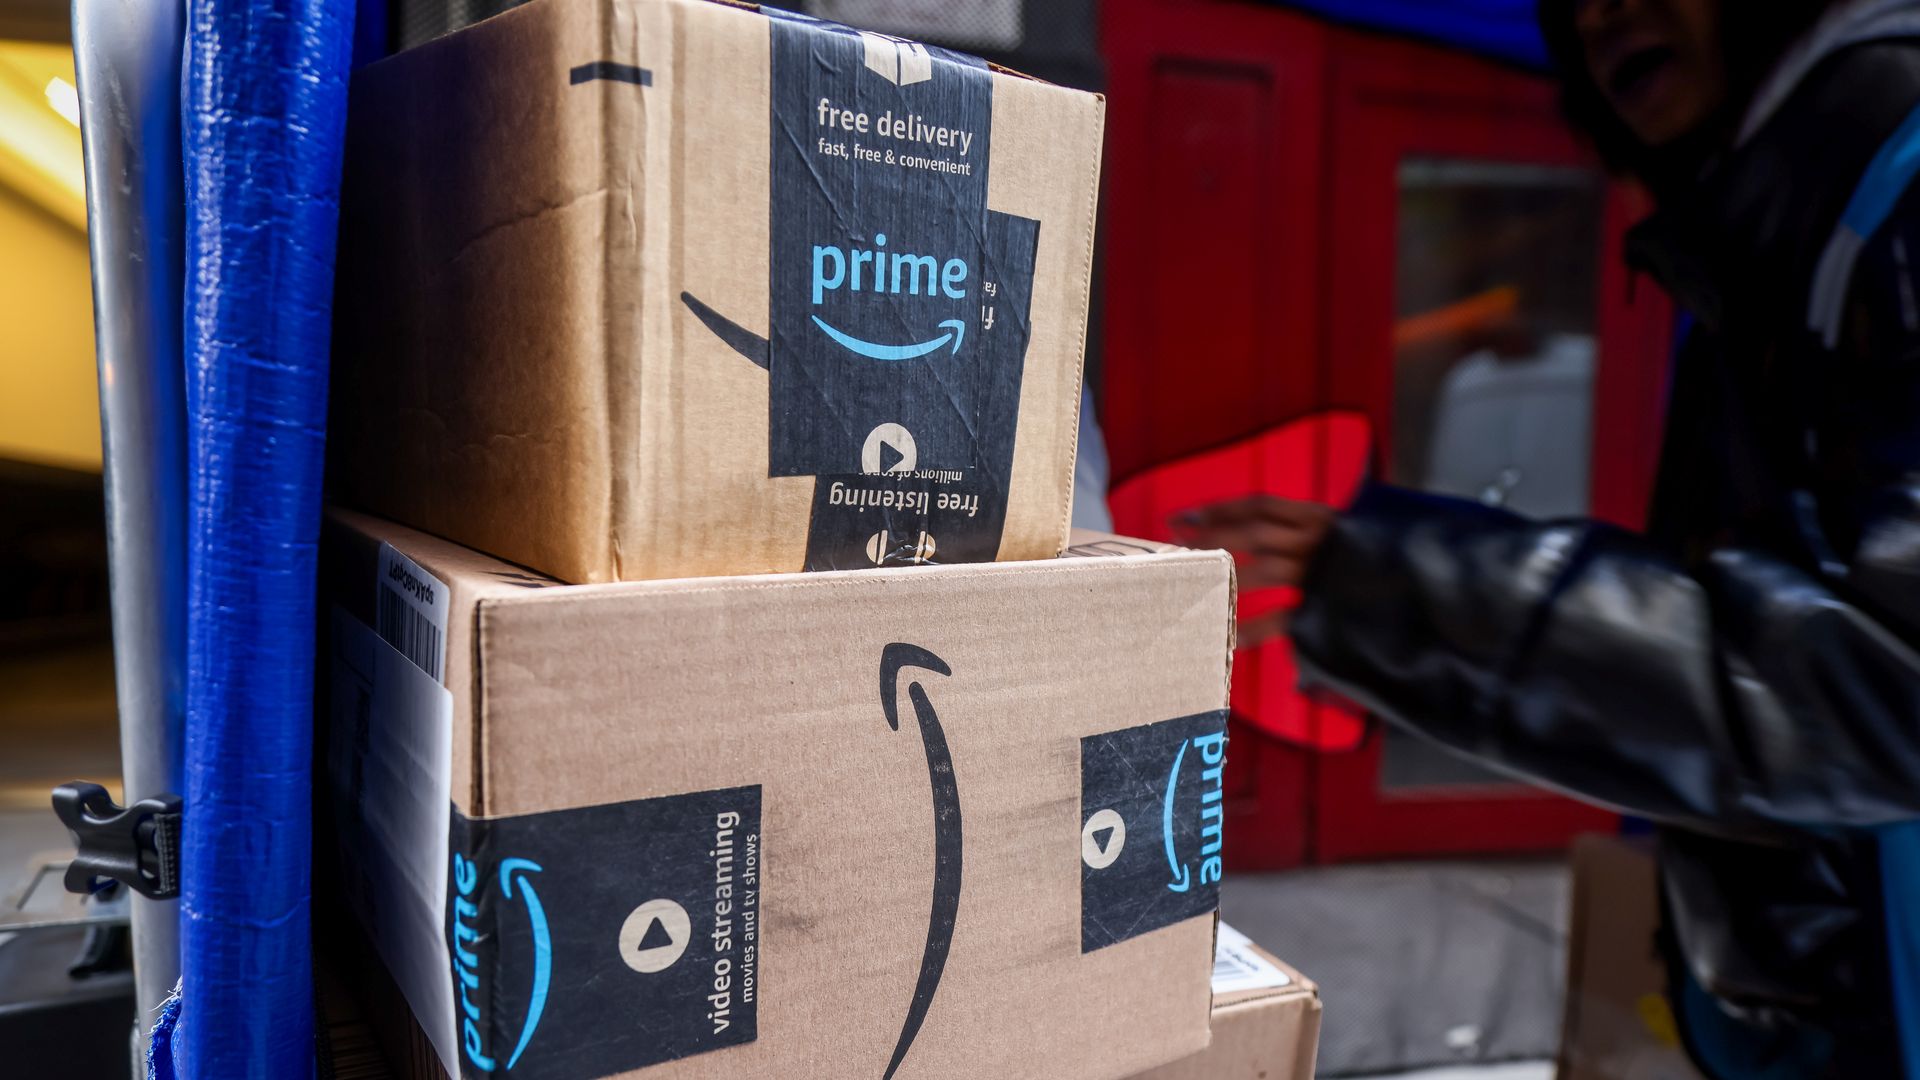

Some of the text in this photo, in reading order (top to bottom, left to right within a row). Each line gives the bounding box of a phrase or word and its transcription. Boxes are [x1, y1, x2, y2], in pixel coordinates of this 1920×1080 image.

[818, 98, 973, 156] free delivery
[818, 137, 971, 176] fast, free & convenient
[812, 233, 968, 305] prime
[830, 482, 979, 517] free listening
[915, 469, 962, 483] millions
[1194, 731, 1225, 884] prime
[708, 810, 740, 1035] video streaming
[741, 833, 757, 1003] movies and tv shows
[453, 852, 497, 1072] prime
